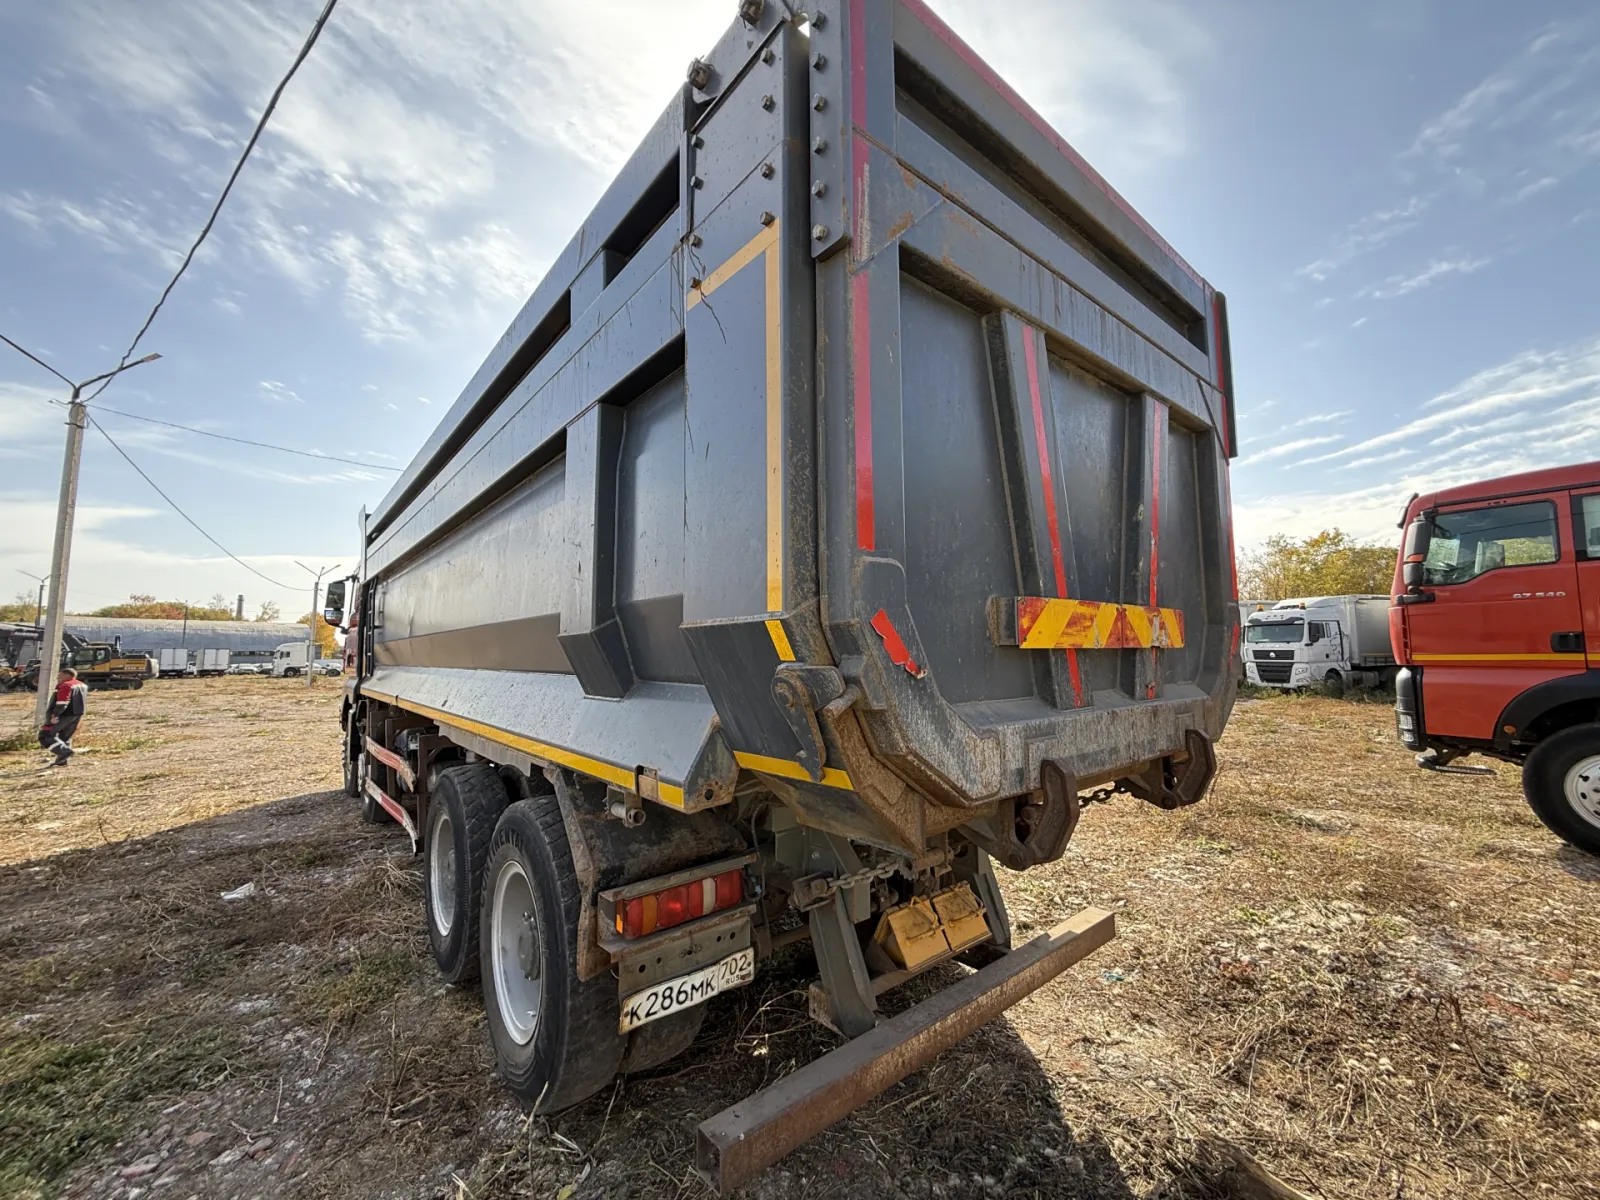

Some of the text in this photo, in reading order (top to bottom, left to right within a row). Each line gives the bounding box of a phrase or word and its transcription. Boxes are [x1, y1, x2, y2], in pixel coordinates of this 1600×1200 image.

[629, 953, 748, 1026] K286MK 702
[725, 973, 741, 986] RUS
